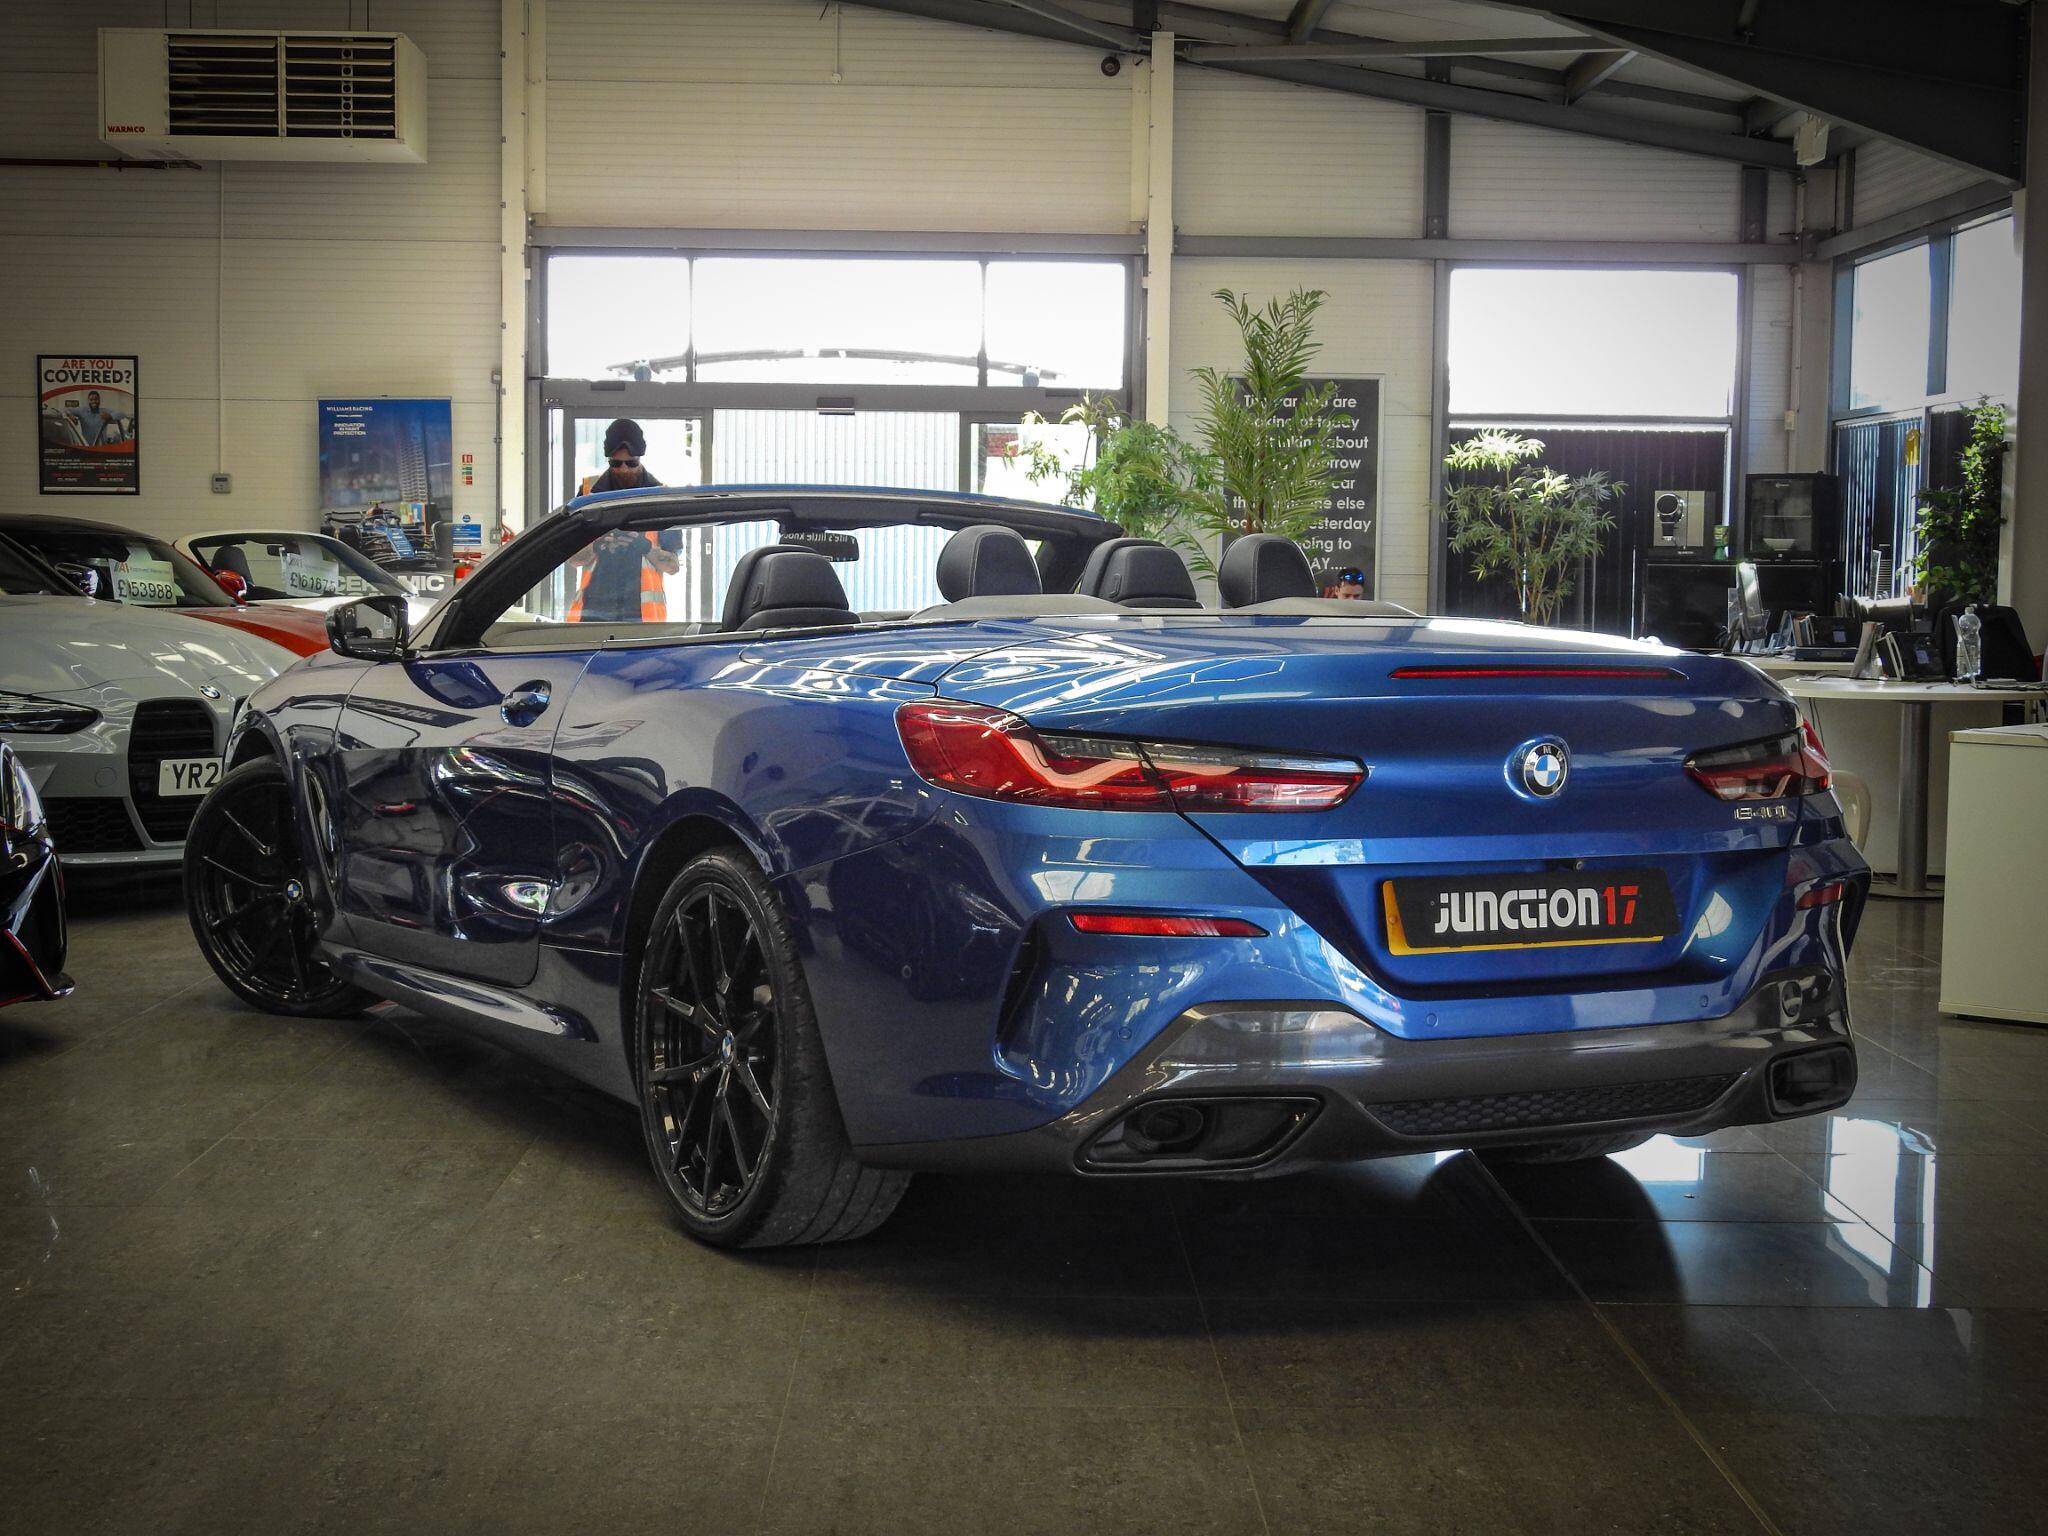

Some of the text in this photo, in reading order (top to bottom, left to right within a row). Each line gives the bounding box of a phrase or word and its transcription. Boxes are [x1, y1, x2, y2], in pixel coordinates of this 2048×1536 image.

[62, 359, 114, 370] ARE YOU
[44, 369, 132, 383] COVERED?
[1332, 396, 1358, 408] are
[1326, 436, 1369, 449] about
[1331, 479, 1355, 490] car
[1336, 497, 1366, 510] else
[1302, 517, 1371, 532] esterday
[1299, 537, 1352, 553] oing to
[172, 762, 219, 790] YR2
